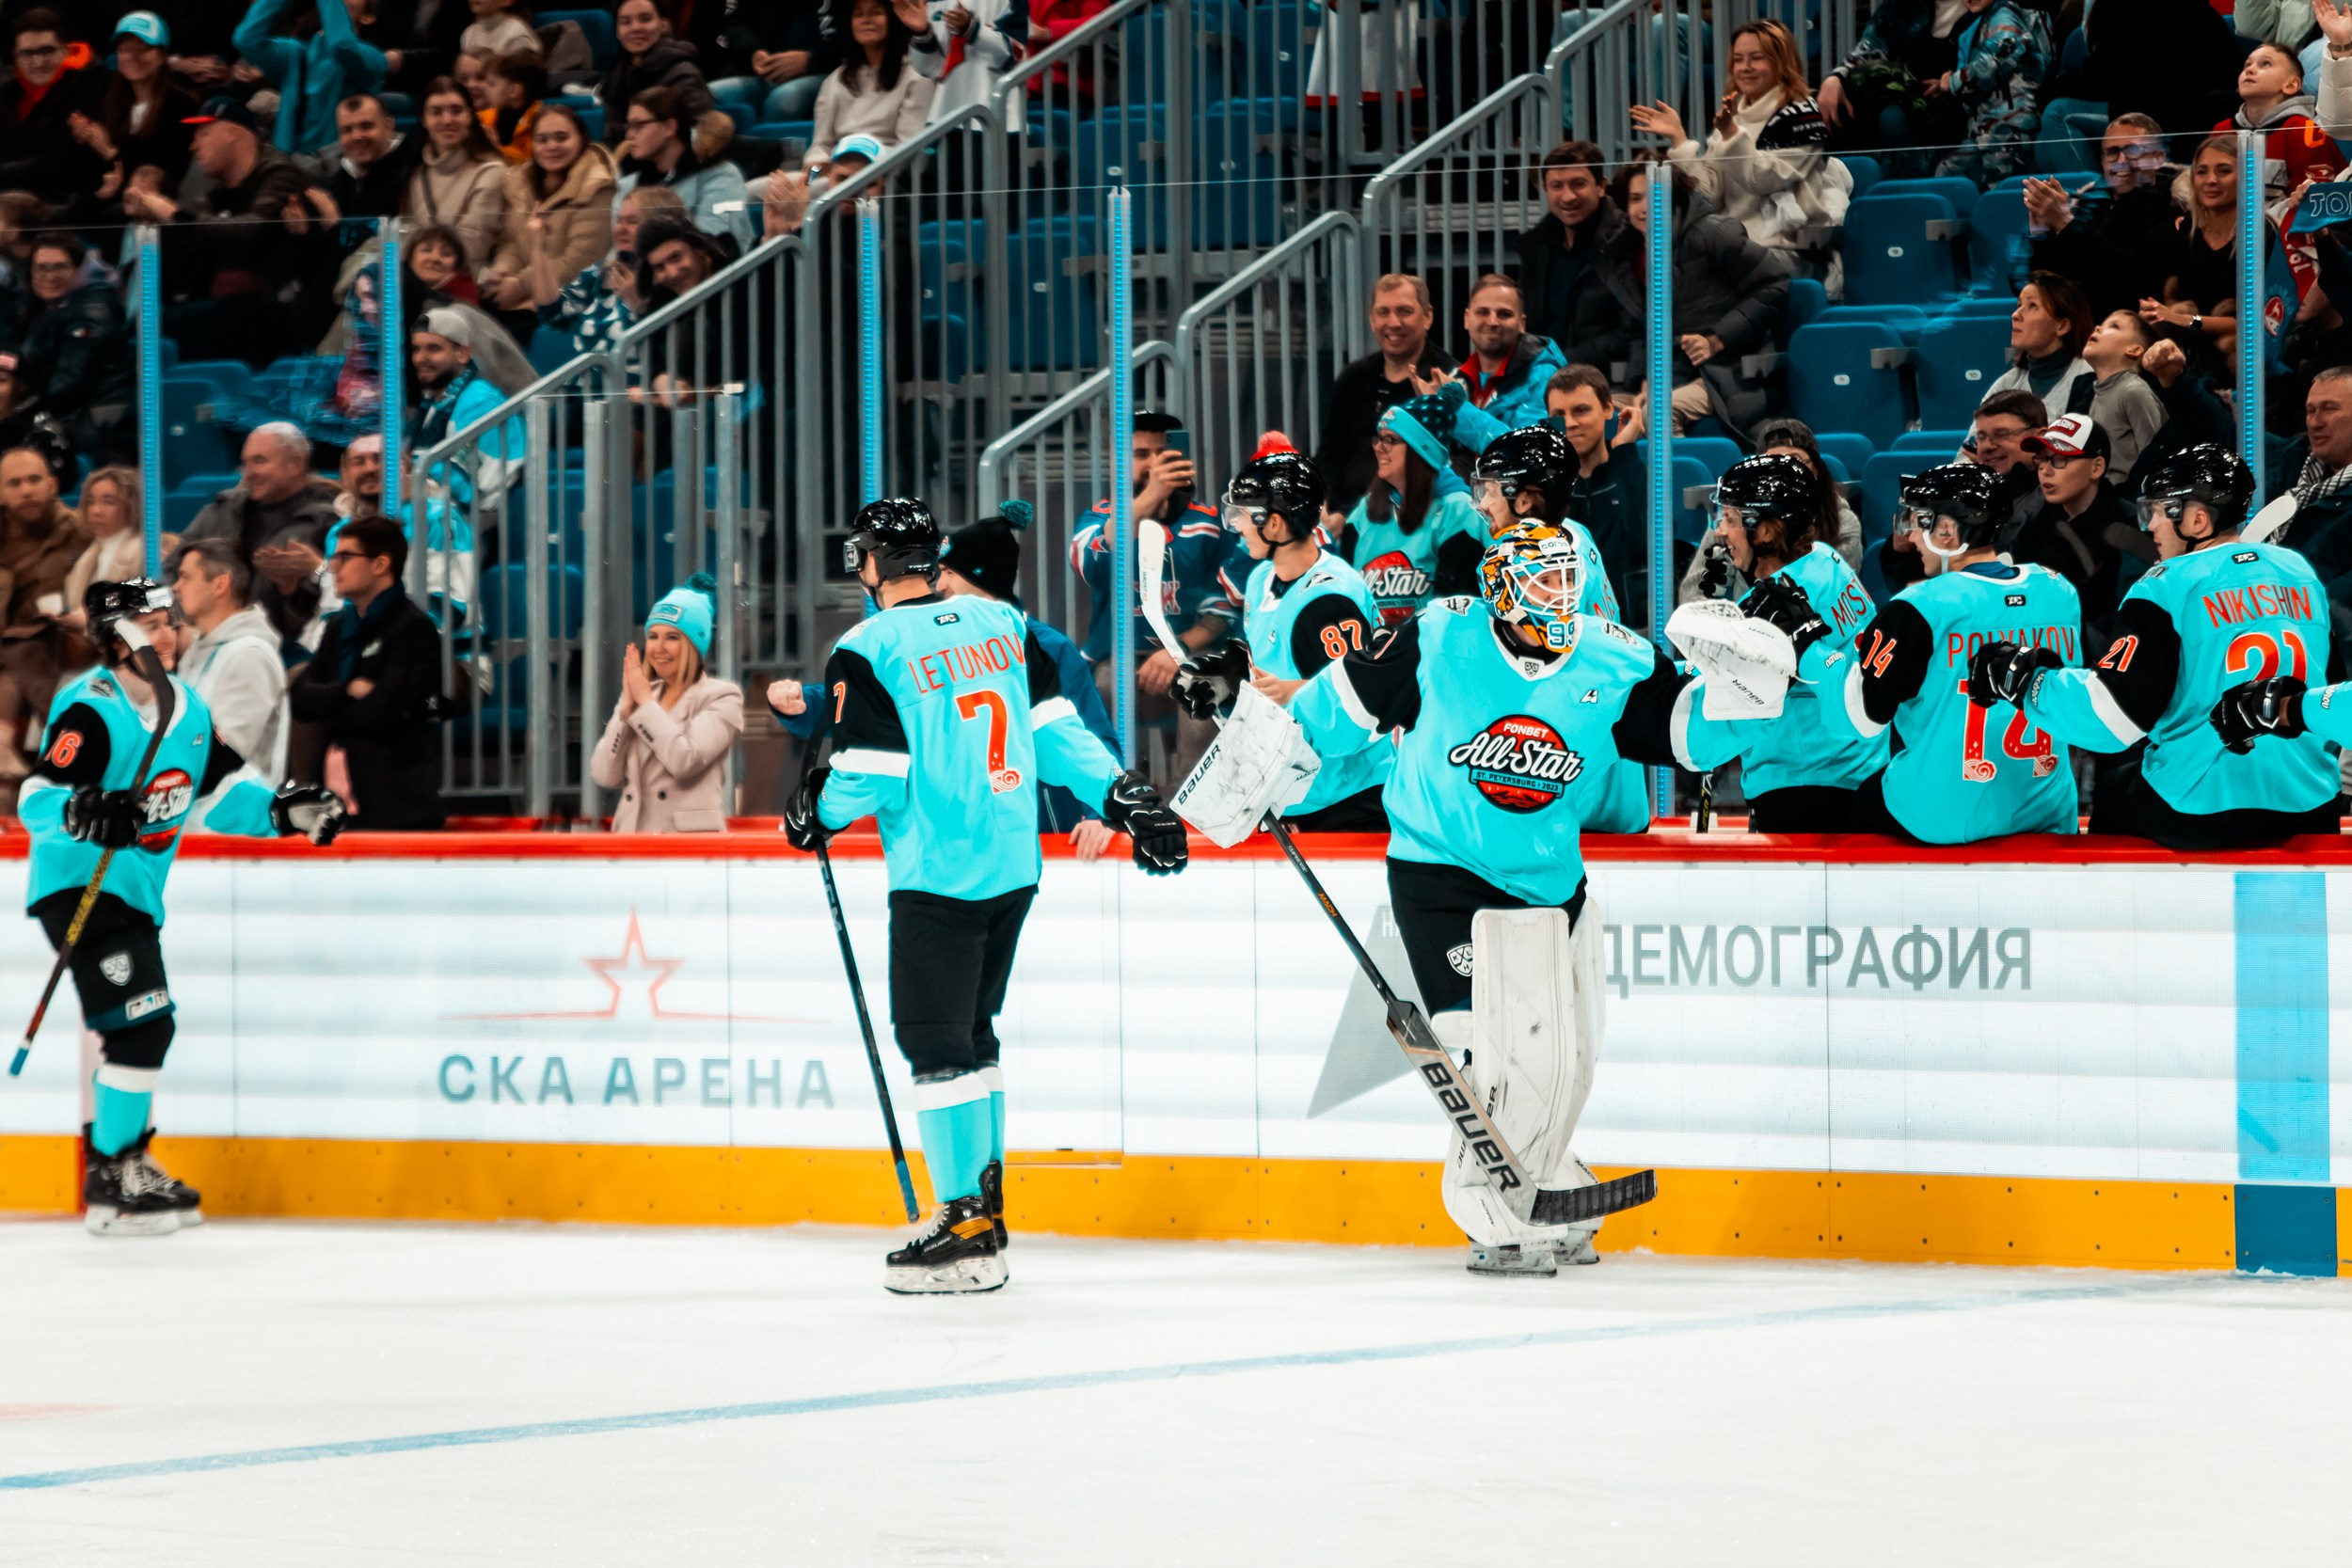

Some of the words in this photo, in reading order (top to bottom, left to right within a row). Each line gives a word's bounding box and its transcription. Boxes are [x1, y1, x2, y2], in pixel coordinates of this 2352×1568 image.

[2201, 583, 2313, 629] NIKISHIN
[1320, 619, 1363, 660] 87
[1862, 628, 1898, 678] 14
[2097, 634, 2138, 673] 21
[908, 632, 1025, 694] LETUNOV
[834, 680, 847, 724] 7
[955, 689, 1023, 795] 7
[1502, 721, 1549, 738] FONBET
[1450, 732, 1582, 782] All-Star
[1476, 770, 1487, 781] ST.
[1488, 773, 1536, 788] PETERSBURG
[1541, 782, 1560, 792] 2023
[1317, 893, 1338, 917] MACH
[1602, 924, 2032, 999] ДЕМОГРАФИЯ
[437, 1053, 575, 1105] СКА
[603, 1056, 835, 1110] АРЕНА
